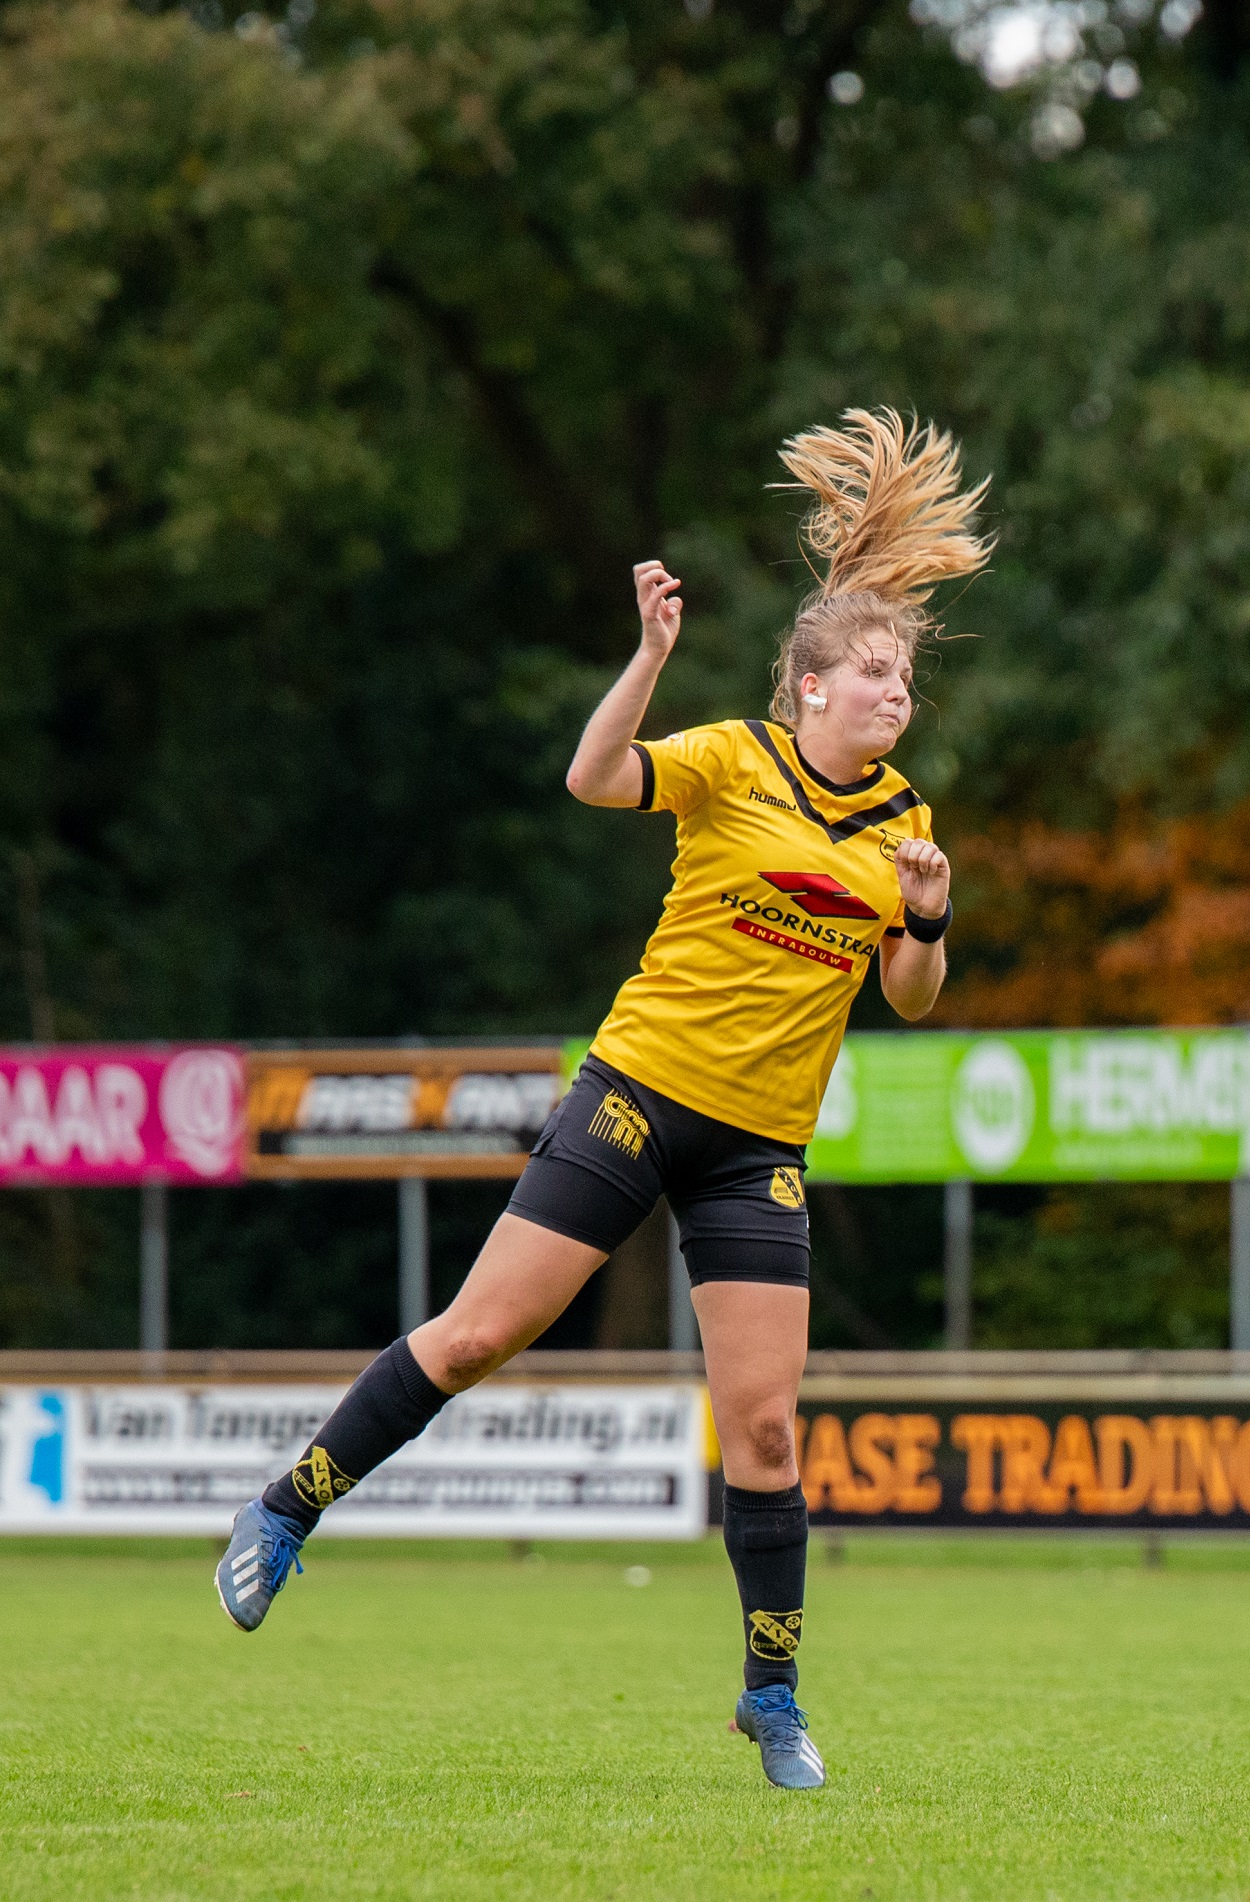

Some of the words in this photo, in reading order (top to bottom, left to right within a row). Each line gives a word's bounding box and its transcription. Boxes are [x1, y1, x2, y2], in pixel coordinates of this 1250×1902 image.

[720, 893, 875, 957] HOORNSTRA
[750, 926, 842, 967] INFRABOUW
[0, 1063, 146, 1166] AAR
[797, 1413, 943, 1517] ASE
